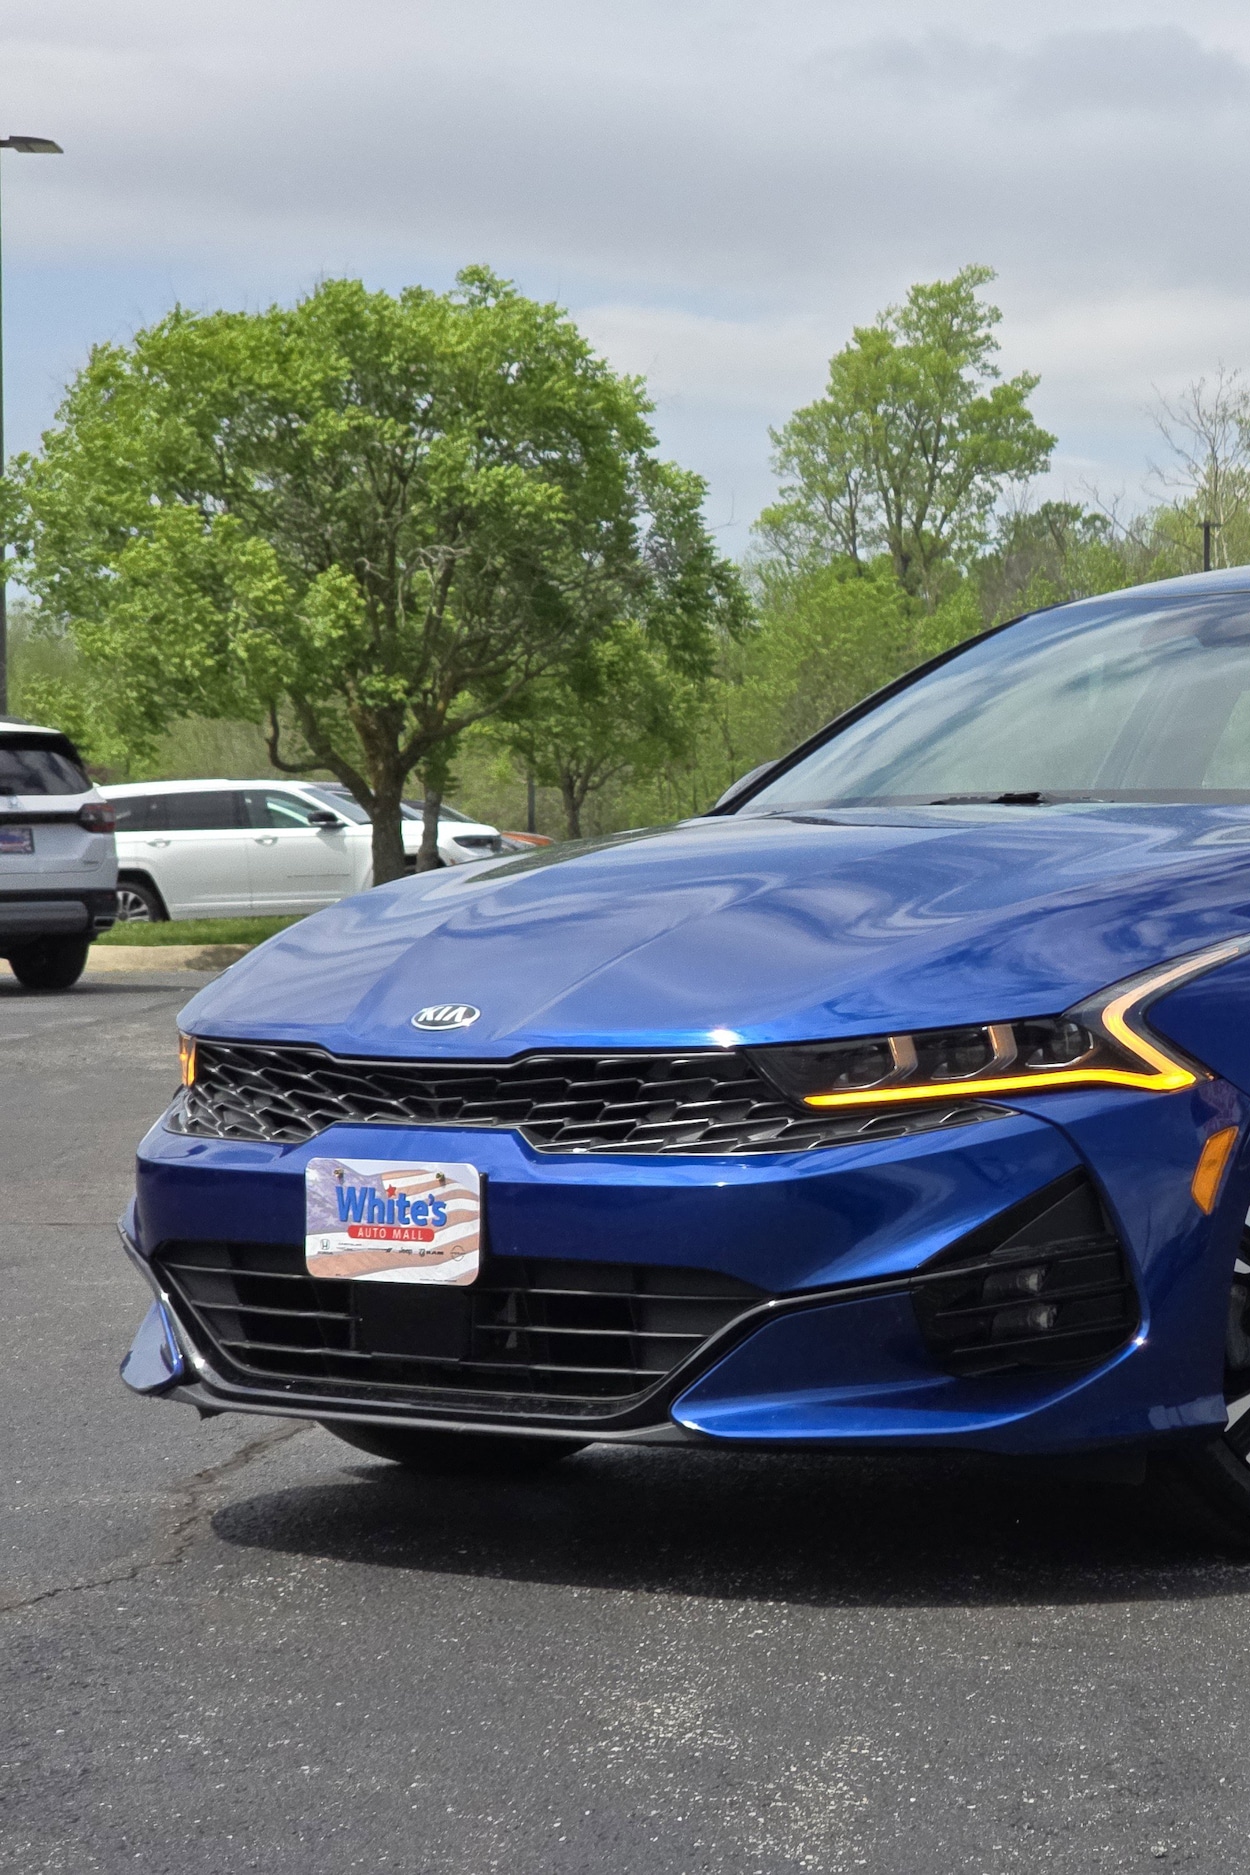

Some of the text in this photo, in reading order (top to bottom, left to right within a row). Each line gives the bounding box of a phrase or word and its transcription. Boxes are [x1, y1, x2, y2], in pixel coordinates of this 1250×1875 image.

[416, 1005, 468, 1022] KIA
[335, 1185, 447, 1227] White's
[357, 1227, 424, 1240] AUTO MALL
